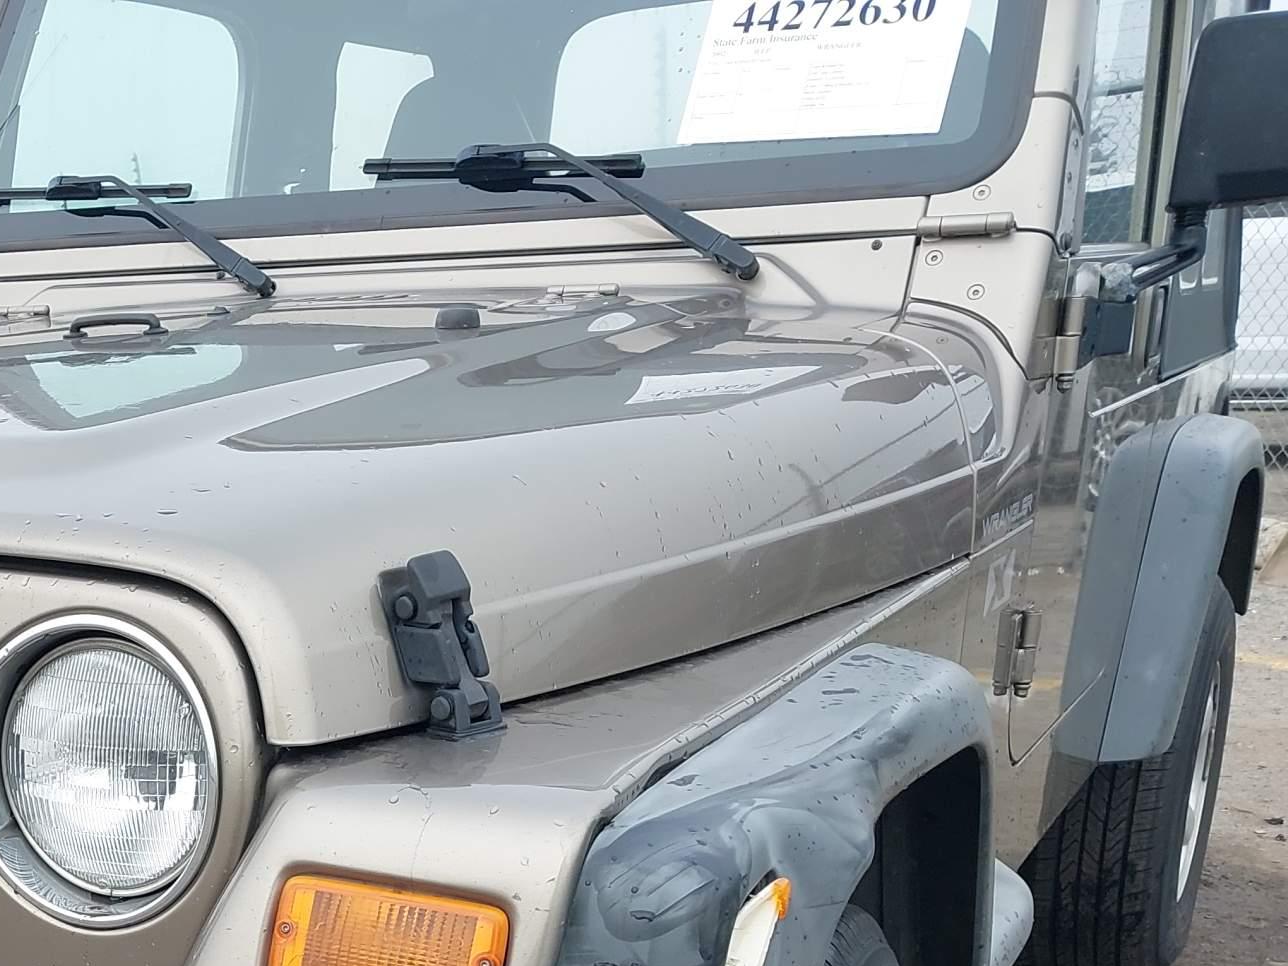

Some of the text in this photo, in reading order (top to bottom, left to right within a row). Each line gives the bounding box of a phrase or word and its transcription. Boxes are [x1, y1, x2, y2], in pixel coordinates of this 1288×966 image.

[732, 0, 937, 34] 44272630
[712, 33, 820, 48] State Farm Insurance
[982, 493, 1034, 537] WRANGLER
